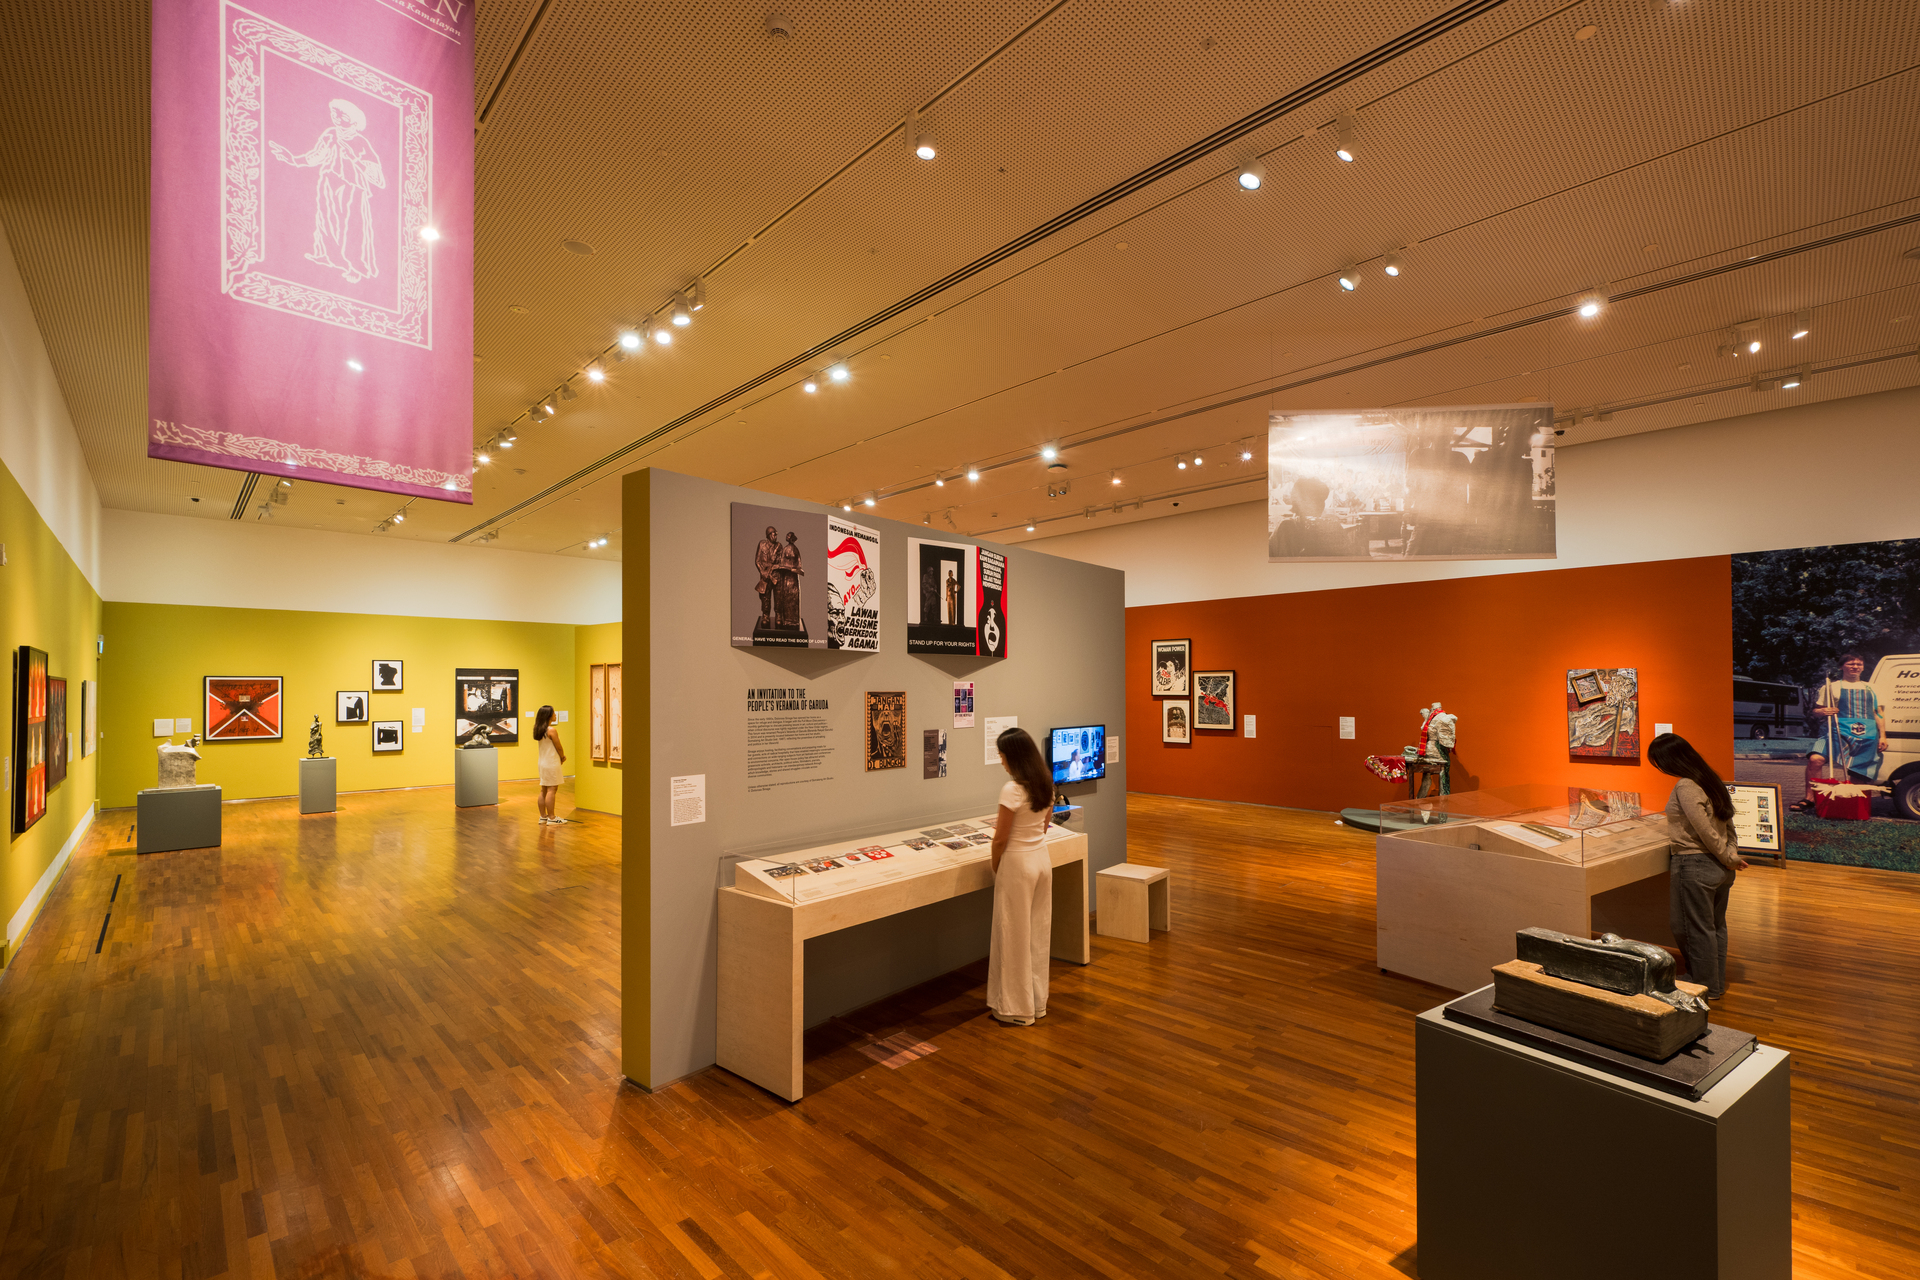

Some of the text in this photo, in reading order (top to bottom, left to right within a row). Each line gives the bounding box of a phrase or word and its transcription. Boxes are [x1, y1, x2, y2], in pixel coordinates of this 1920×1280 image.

[406, 2, 461, 36] Kamalayan
[829, 524, 854, 537] INDONESIA
[851, 607, 879, 619] LAWAN
[844, 617, 878, 630] FASISME
[844, 627, 878, 639] BERKEDOK
[848, 637, 878, 650] AGAMA!
[747, 688, 806, 700] AN INVITATION TO THE
[747, 699, 829, 712] PEOPLE'S VERANDA OF GARUDA
